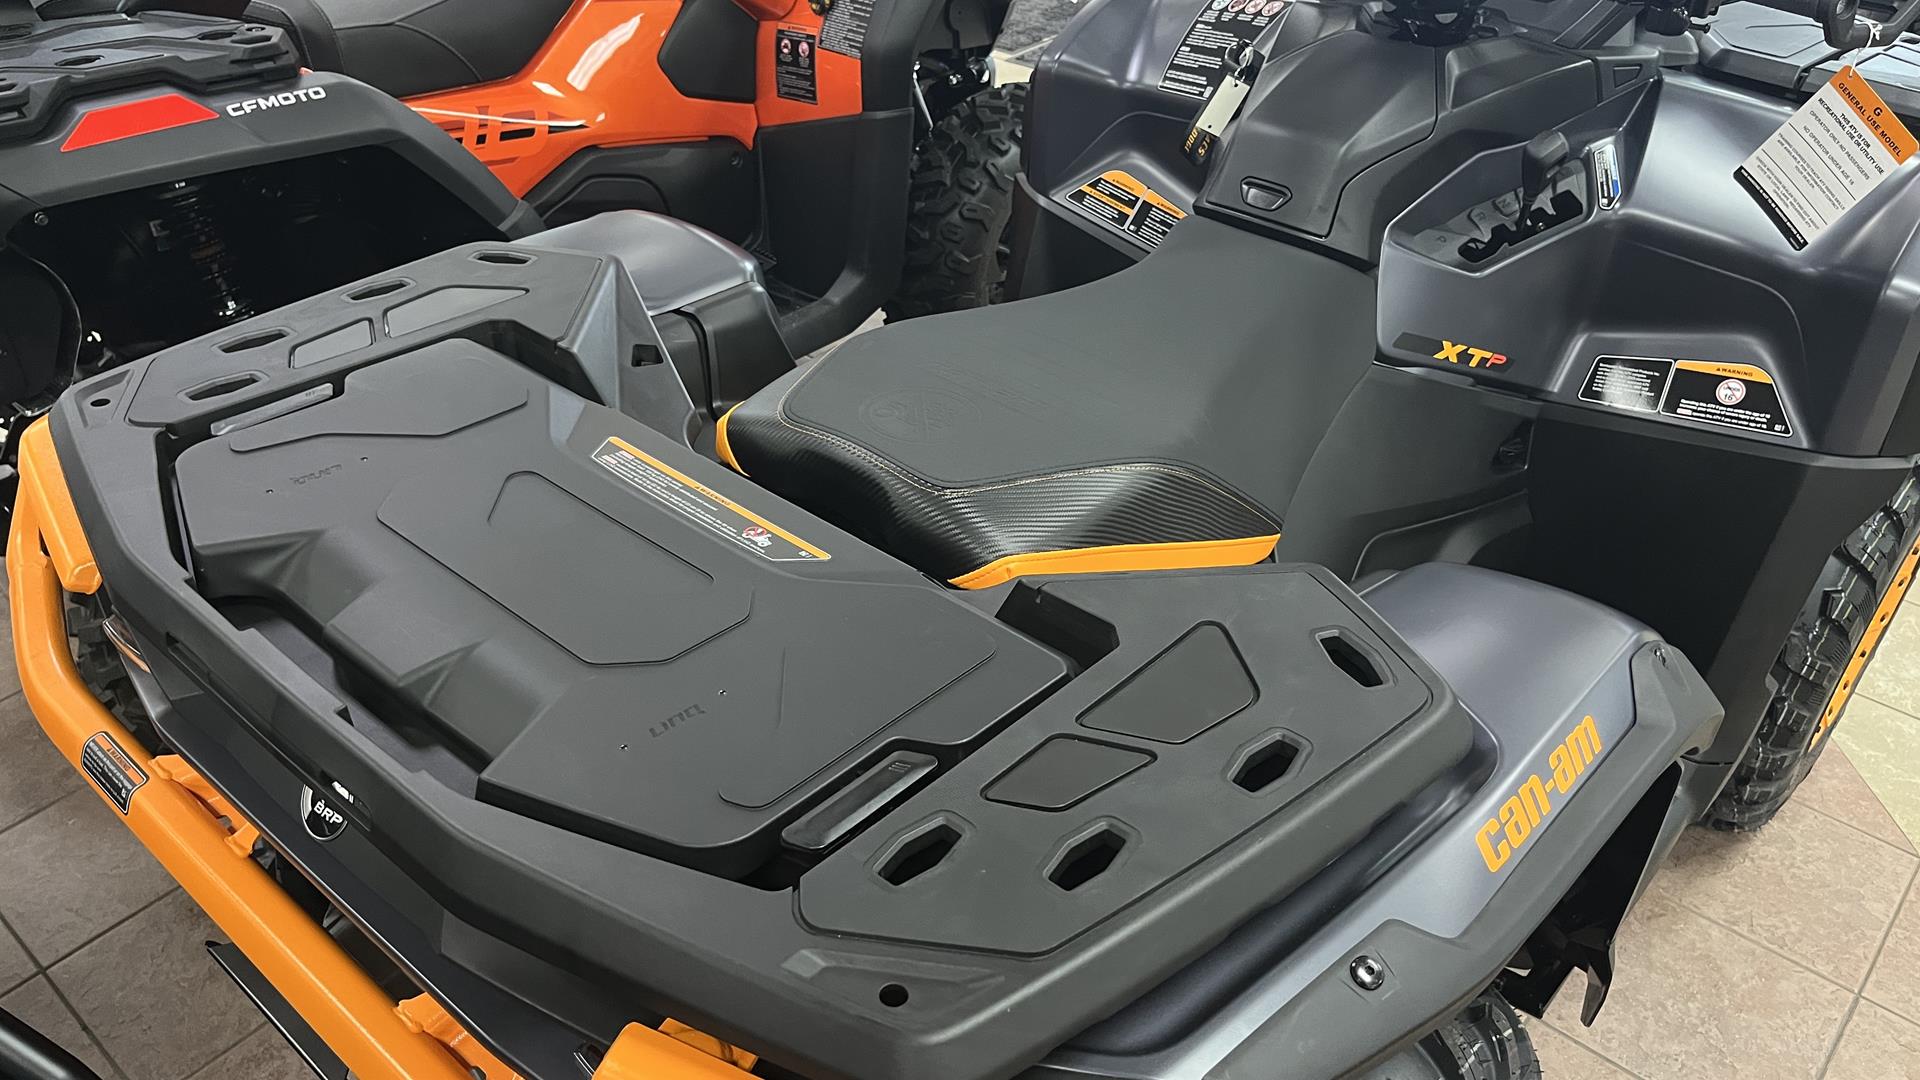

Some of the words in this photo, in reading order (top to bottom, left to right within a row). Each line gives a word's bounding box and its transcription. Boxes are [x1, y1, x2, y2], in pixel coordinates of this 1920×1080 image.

[226, 87, 326, 116] CFMOTO
[1837, 81, 1867, 115] GENERAL
[1865, 114, 1880, 131] USE
[1878, 130, 1902, 156] MODEL
[1872, 105, 1883, 117] G
[1802, 125, 1810, 133] NO
[1808, 131, 1829, 155] OPERATOR
[1827, 154, 1842, 170] UNDER
[1840, 168, 1850, 179] AGE
[1809, 109, 1830, 134] OPERATOR
[1844, 150, 1870, 180] PASSENGERS
[1817, 97, 1847, 131] RECREATIONAL
[1845, 129, 1855, 140] USE
[1853, 139, 1861, 148] OR
[1859, 145, 1876, 165] UTILITY
[1873, 163, 1884, 174] USE
[1839, 112, 1850, 125] THIS
[1848, 123, 1858, 134] ATV
[1860, 137, 1870, 148] FOR
[1721, 368, 1753, 377] WARNING
[314, 801, 343, 823] BRP
[1475, 715, 1602, 872] can-am
